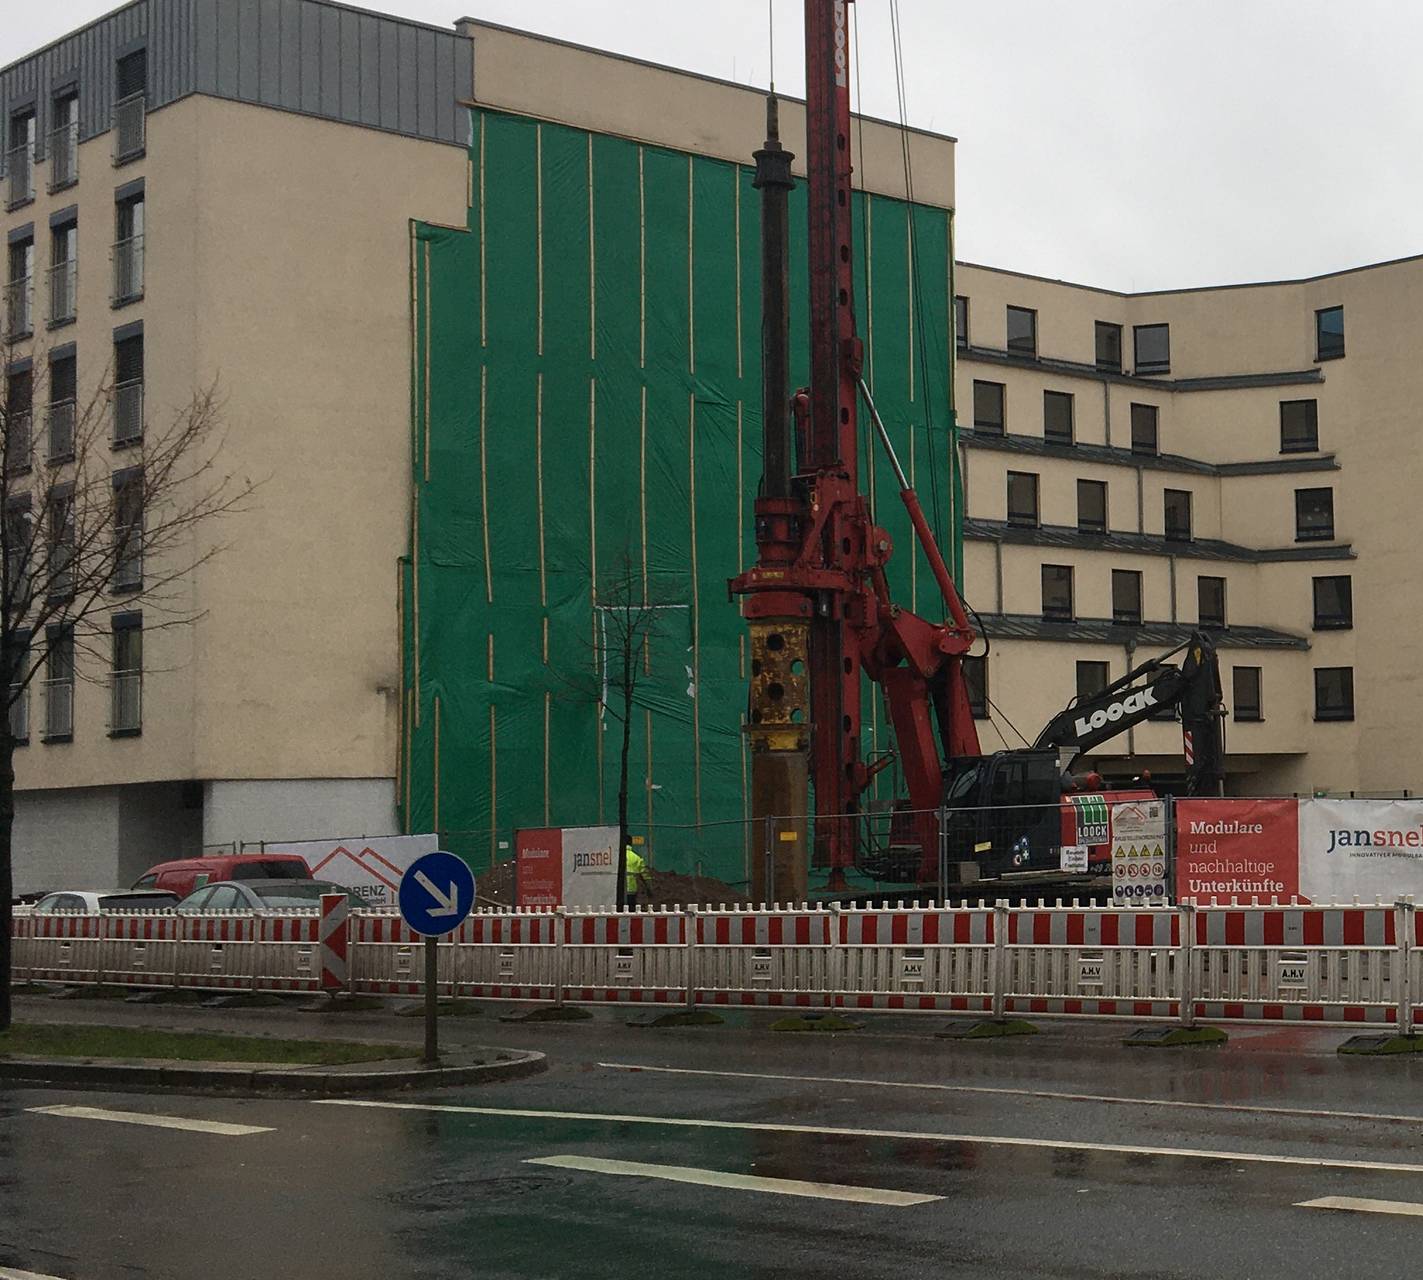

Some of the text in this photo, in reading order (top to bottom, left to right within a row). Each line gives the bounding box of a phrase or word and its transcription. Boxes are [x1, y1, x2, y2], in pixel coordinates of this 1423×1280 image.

[1074, 686, 1158, 737] LOOCK
[1078, 825, 1107, 837] LOOCK
[1190, 821, 1263, 835] Modulare
[1189, 839, 1217, 854] und
[573, 846, 612, 872] jansnel
[1189, 858, 1275, 876] nachhaltige
[1189, 879, 1284, 893] Unterkünfte
[904, 964, 922, 973] A.H.V
[1081, 966, 1100, 976] A.H.V
[1282, 969, 1305, 978] A.H.V
